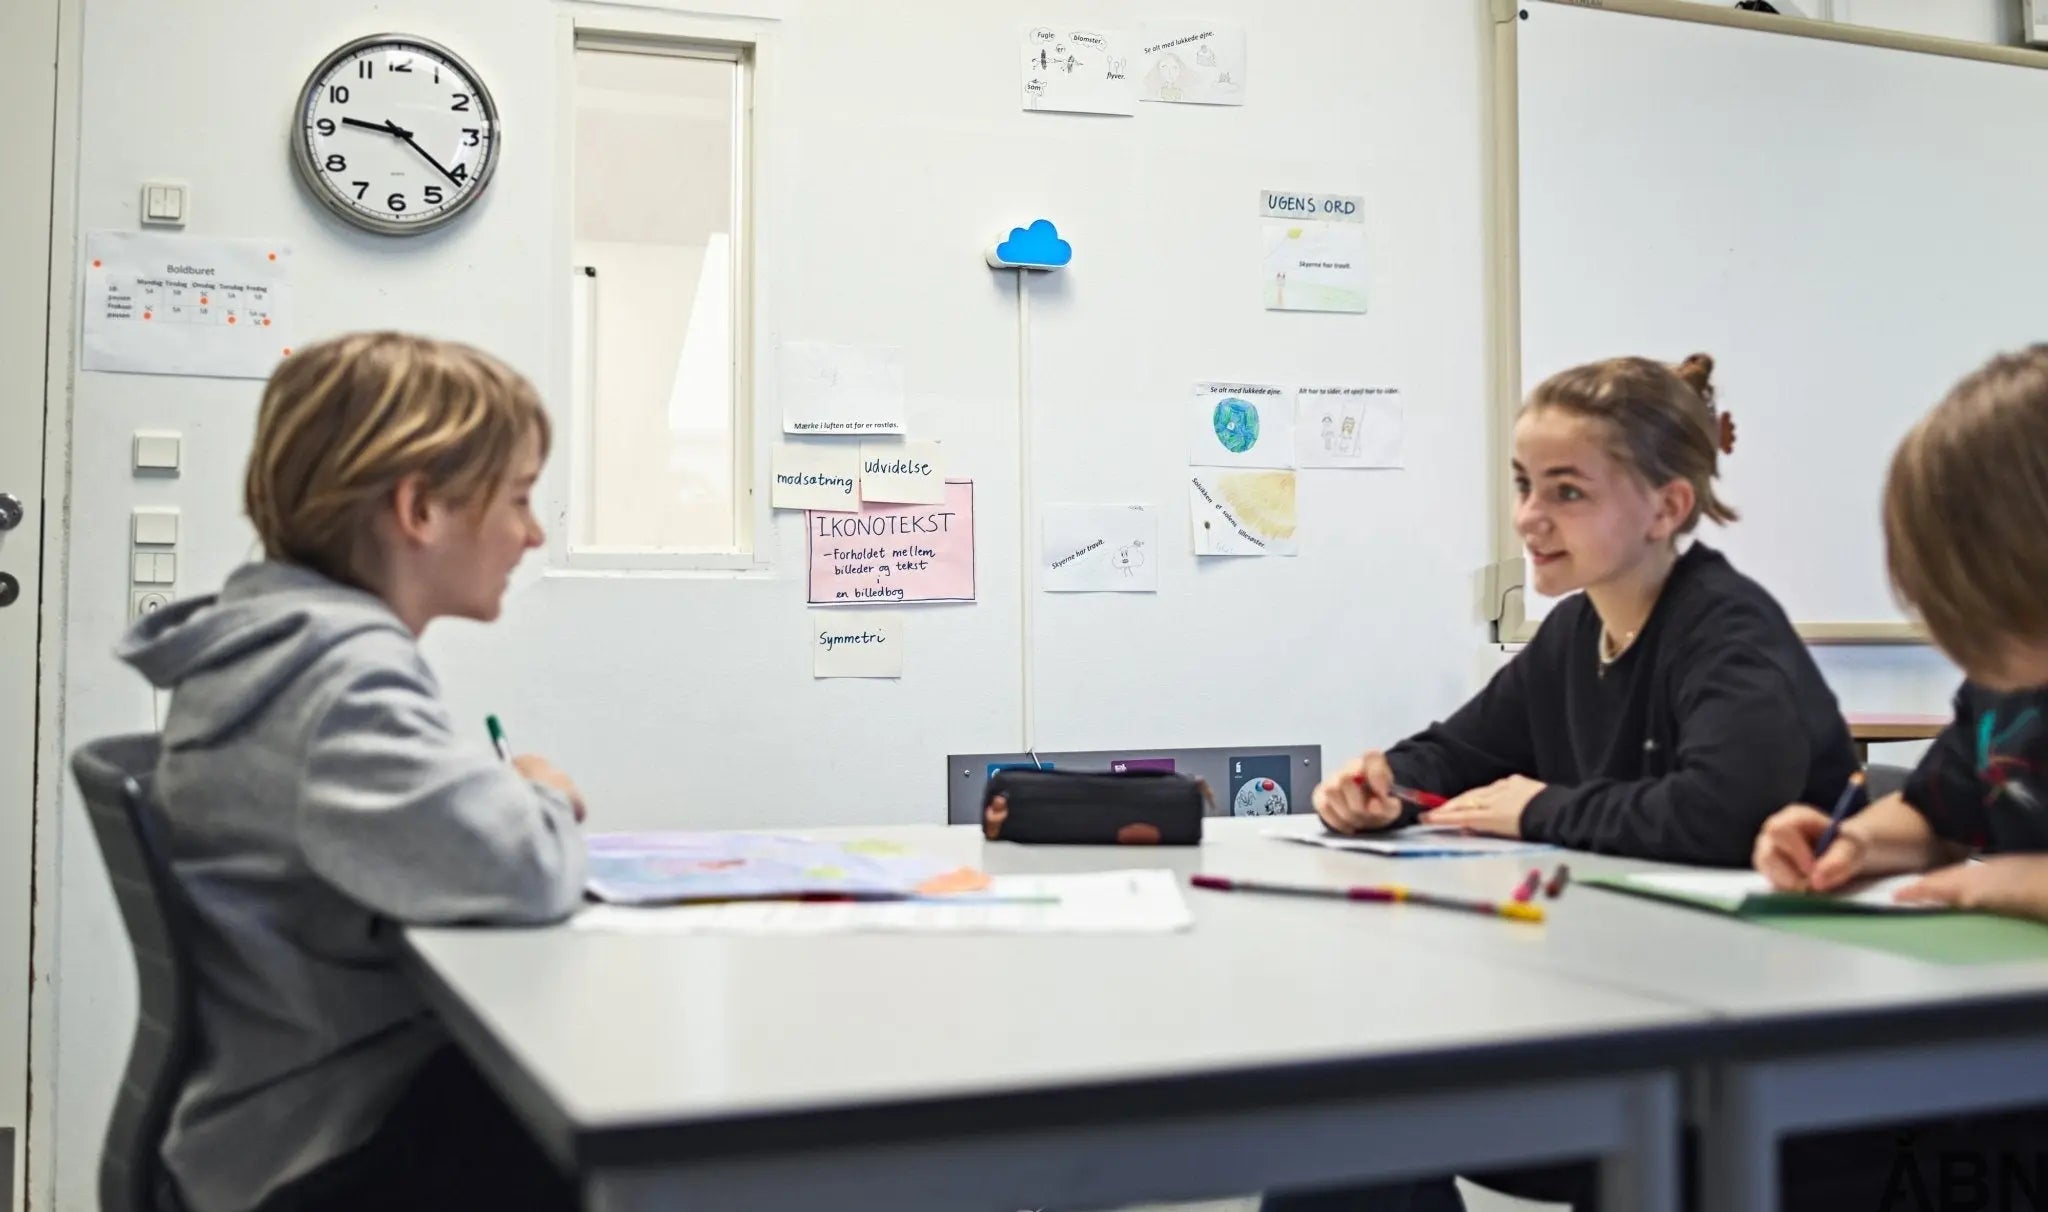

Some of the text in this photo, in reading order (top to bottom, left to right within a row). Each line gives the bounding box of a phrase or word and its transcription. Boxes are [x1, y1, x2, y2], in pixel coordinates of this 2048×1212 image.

[1162, 41, 1175, 49] med
[1175, 34, 1199, 46] lukkede
[358, 60, 373, 79] 11
[329, 85, 350, 104] 10
[1027, 83, 1041, 91] som
[450, 93, 470, 112] 2
[316, 117, 336, 137] 9
[461, 128, 480, 147] 3
[325, 154, 347, 172] 8
[351, 181, 370, 200] 7
[423, 185, 443, 205] 5
[386, 193, 407, 212] 6
[1268, 194, 1356, 215] UGENS ORD
[166, 263, 216, 276] Boldburet
[793, 422, 819, 430] Mærke
[823, 421, 844, 430] luften
[864, 458, 932, 476] udvidelse
[816, 512, 956, 538] IKONOTEKST
[892, 545, 936, 558] mellem
[1075, 548, 1086, 558] har
[834, 559, 929, 577] billeder og tekst
[876, 574, 881, 584] i
[835, 586, 904, 600] en billedbog
[819, 628, 886, 651] Symmetri
